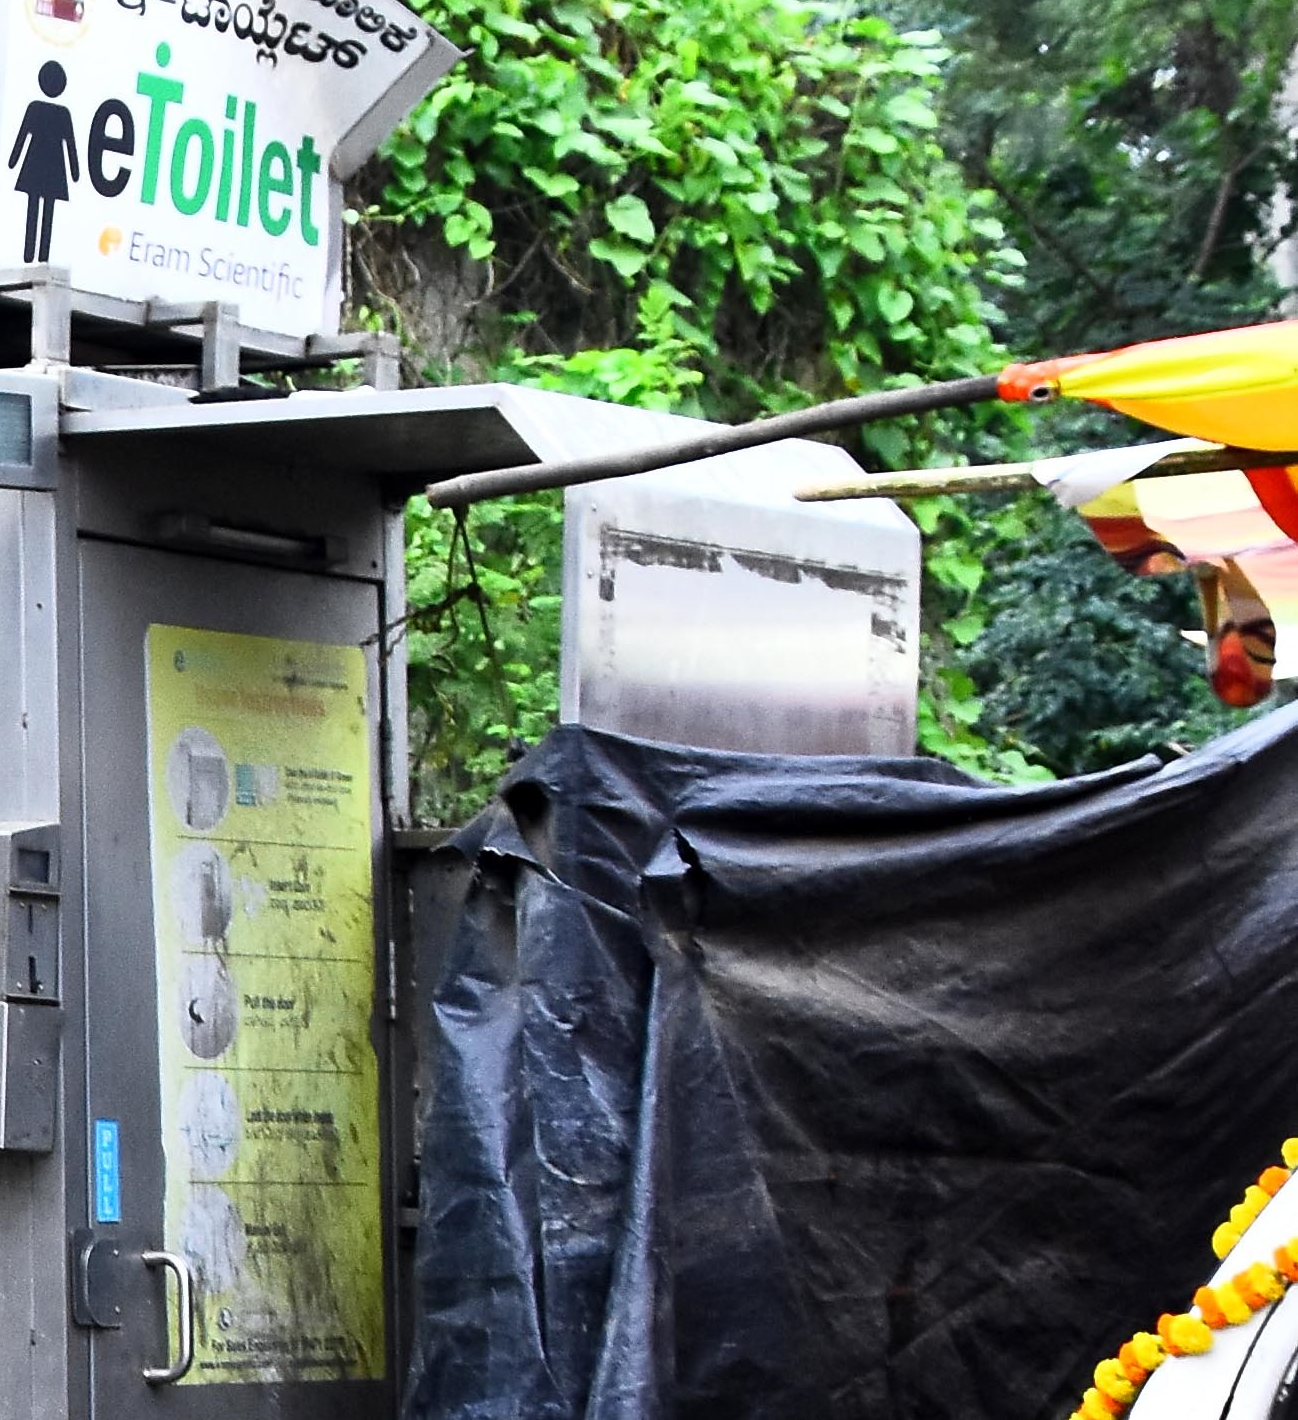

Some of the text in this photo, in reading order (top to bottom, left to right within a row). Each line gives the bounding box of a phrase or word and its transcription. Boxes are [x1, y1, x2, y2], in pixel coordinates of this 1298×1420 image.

[87, 42, 321, 248] eToilet
[129, 231, 304, 301] Eram Scientific
